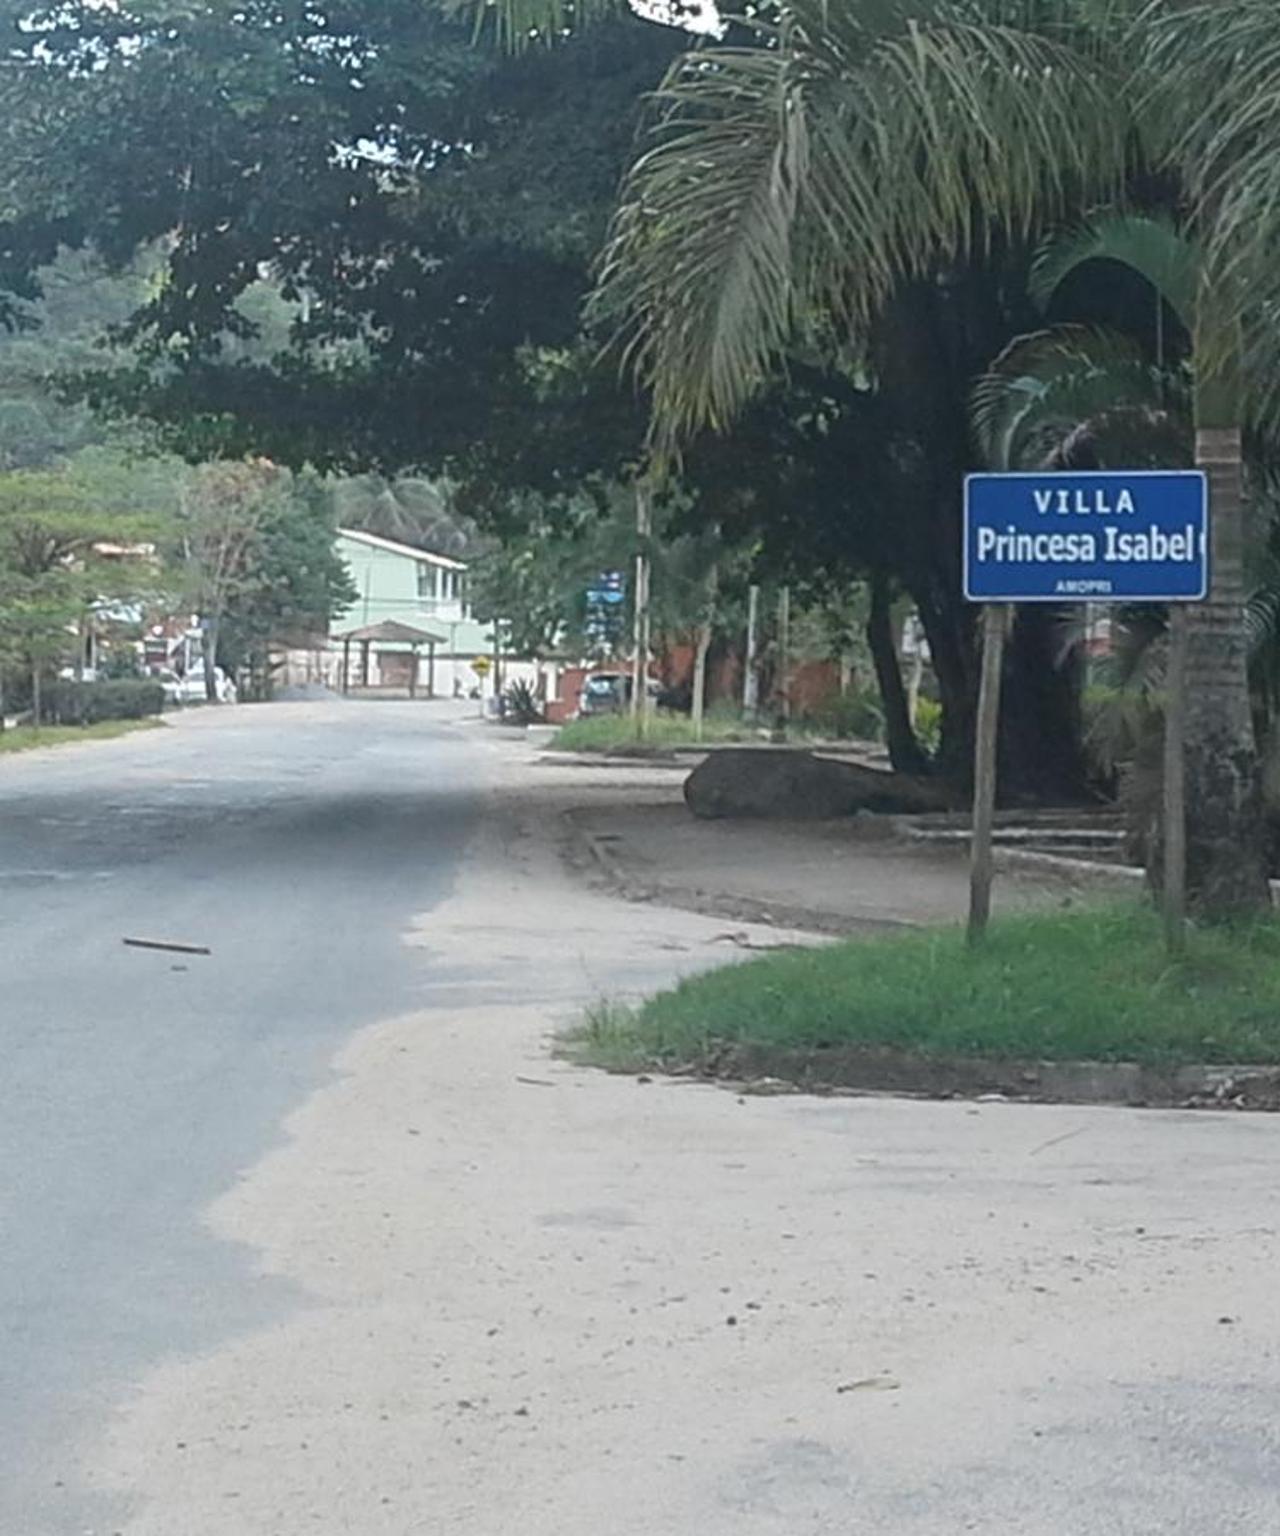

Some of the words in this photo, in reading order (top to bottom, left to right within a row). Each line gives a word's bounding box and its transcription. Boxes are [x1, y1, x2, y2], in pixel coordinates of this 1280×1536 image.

[1033, 490, 1135, 514] VILLA
[977, 525, 1096, 562] Princesa
[1103, 524, 1194, 562] Isabel
